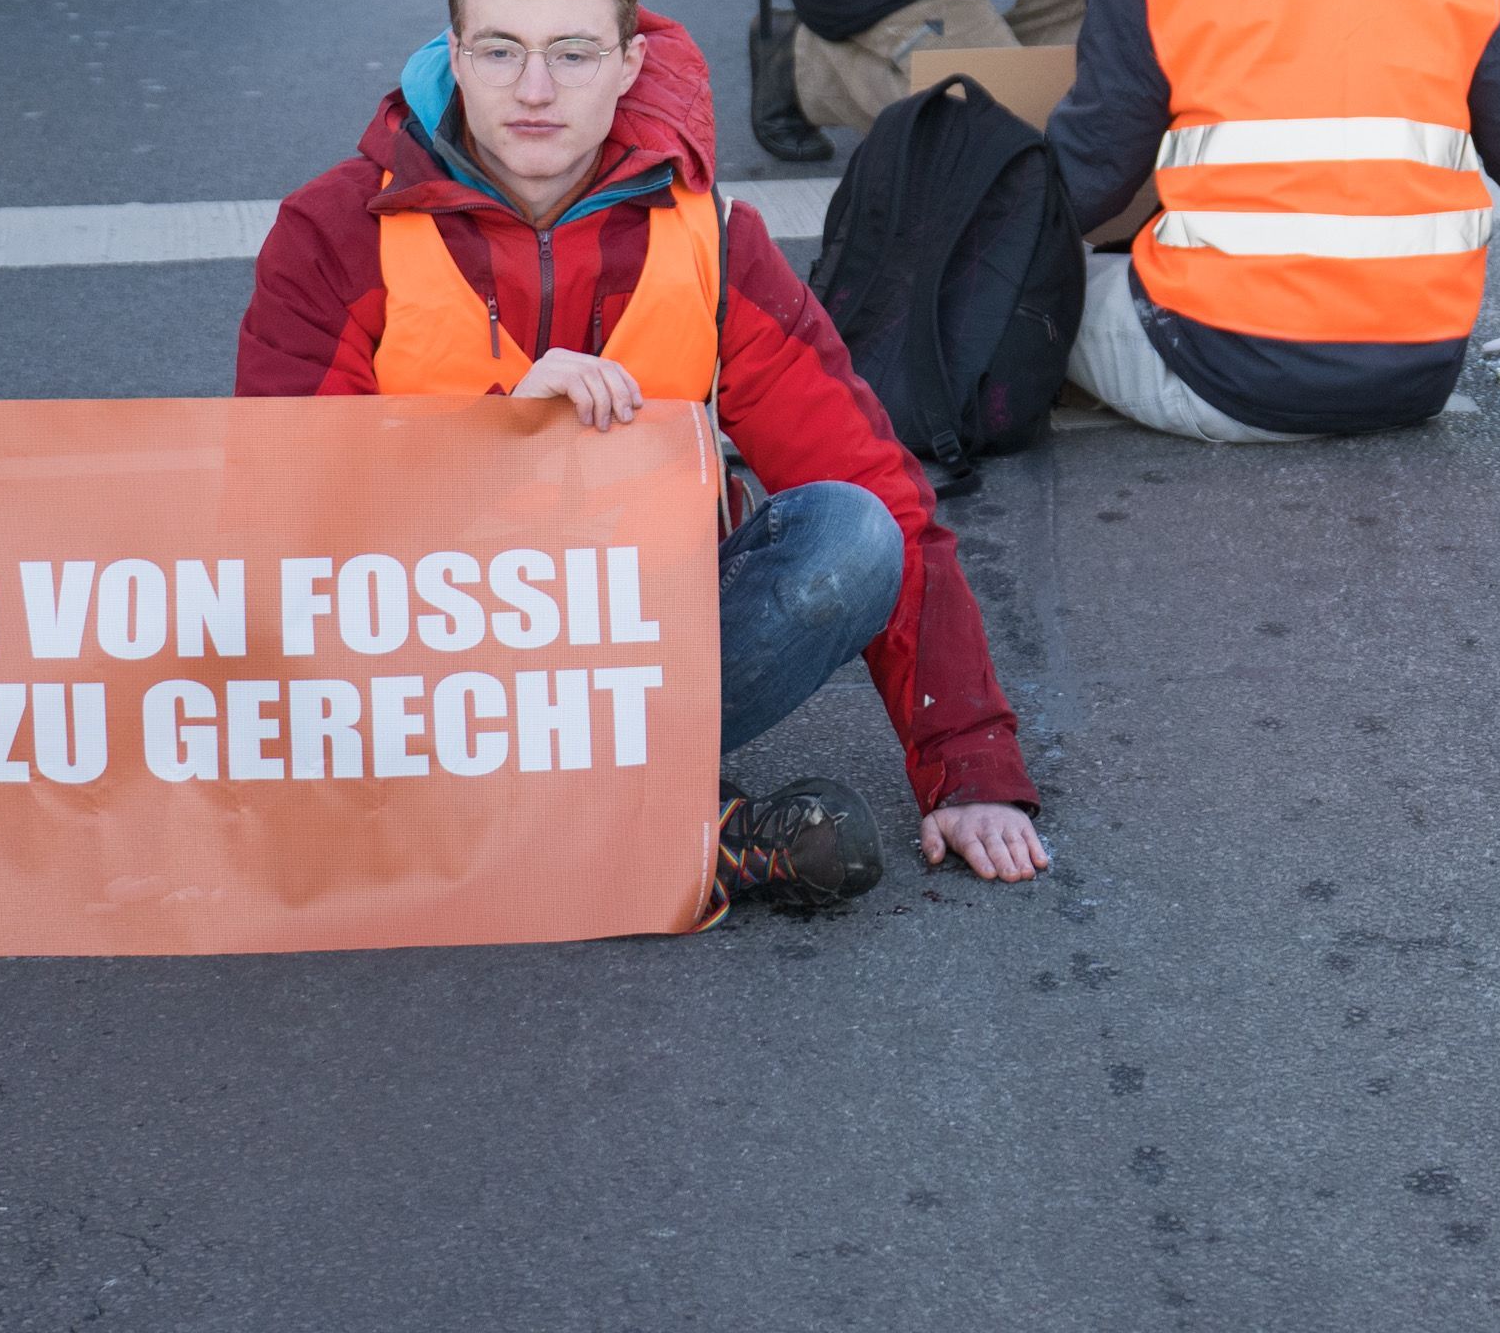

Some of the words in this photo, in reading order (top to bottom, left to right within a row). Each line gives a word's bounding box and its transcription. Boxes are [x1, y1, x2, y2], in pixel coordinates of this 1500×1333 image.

[18, 557, 247, 660] VON
[278, 545, 661, 657] FOSSIL
[143, 664, 663, 783] GERECHT
